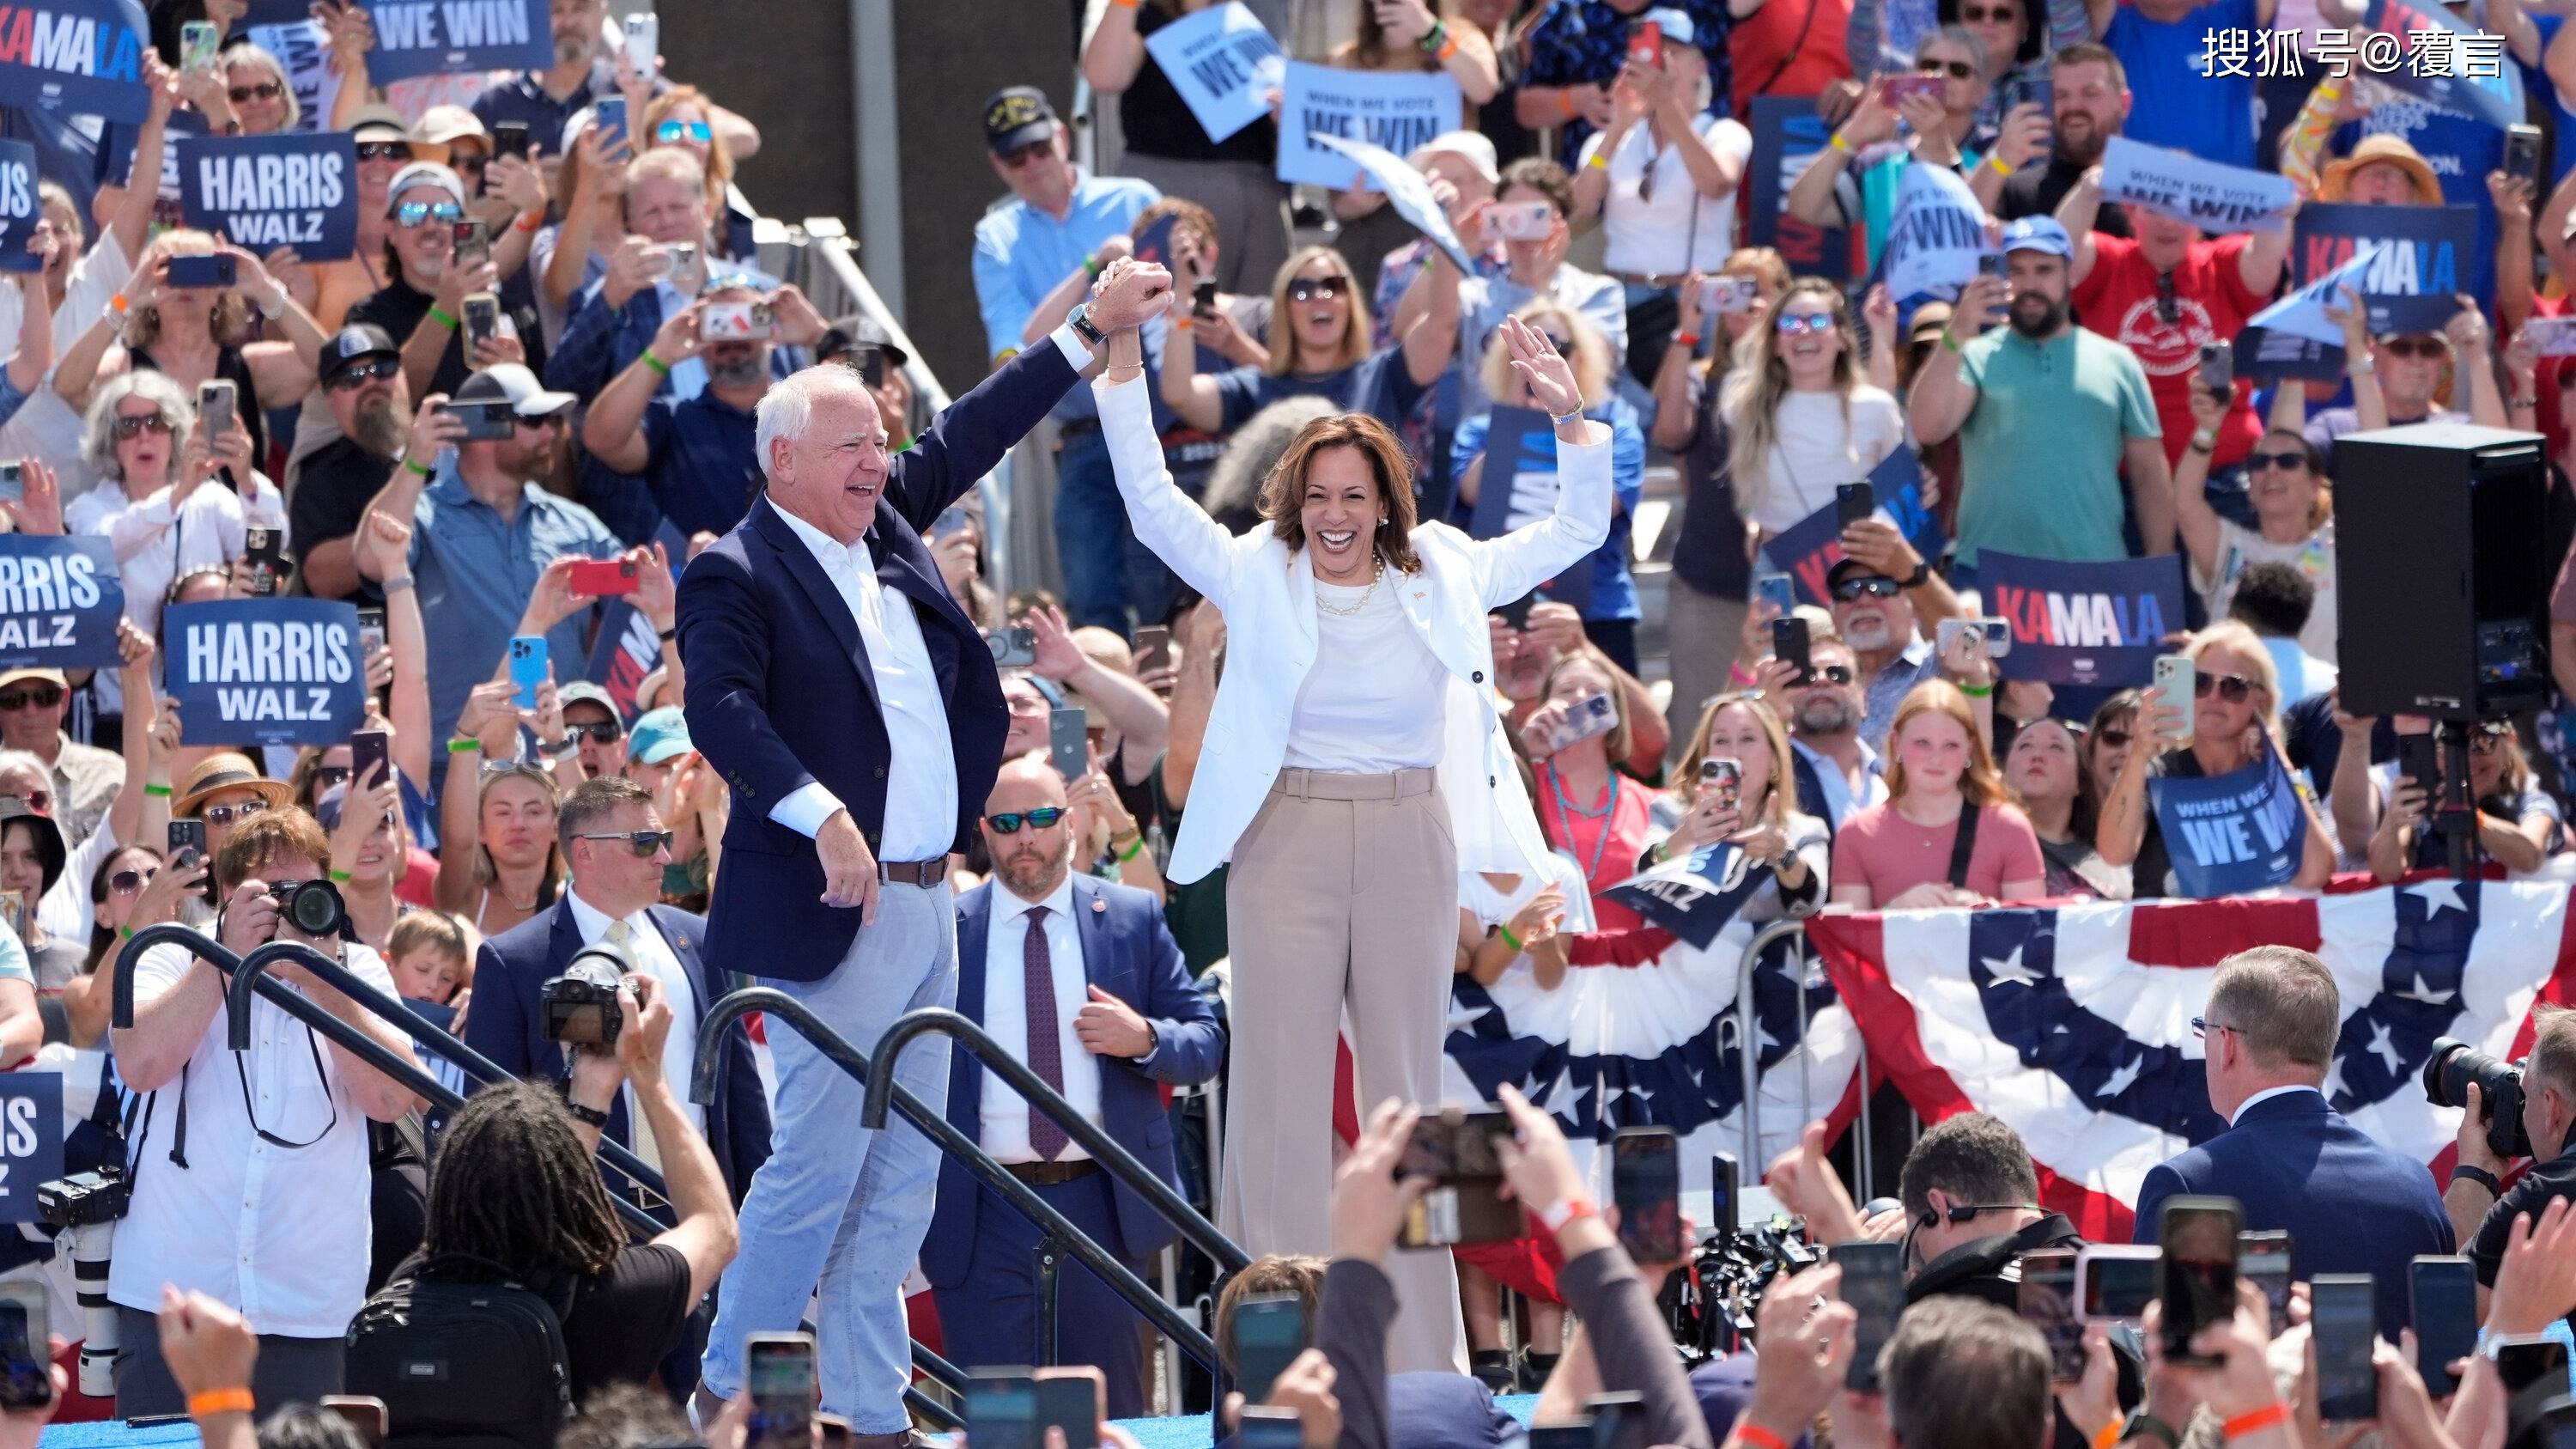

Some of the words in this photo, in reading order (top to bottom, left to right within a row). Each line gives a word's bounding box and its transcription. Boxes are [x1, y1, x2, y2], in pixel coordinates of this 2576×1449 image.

[374, 3, 439, 51] WE
[441, 0, 530, 47] WIN
[1307, 90, 1355, 107] WHEN
[1394, 96, 1435, 111] VOTE
[1303, 107, 1354, 152] WE
[1364, 115, 1438, 159] WIN
[199, 151, 343, 211] HARRIS
[2130, 170, 2184, 190] WHEN
[2189, 182, 2216, 196] WE
[2223, 188, 2268, 204] VOTE
[228, 211, 325, 245] WALZ
[1911, 206, 1983, 250] WIN
[0, 553, 100, 614] RRIS
[0, 614, 76, 649] ALZ
[1996, 585, 2166, 647] KAMALA
[187, 620, 353, 684] HARRIS
[606, 611, 660, 717] KAM
[217, 688, 331, 721] WALZ
[2175, 797, 2238, 818] WHEN
[2239, 782, 2269, 808] WE
[2179, 815, 2257, 867] WE
[1632, 880, 1706, 913] ALZ
